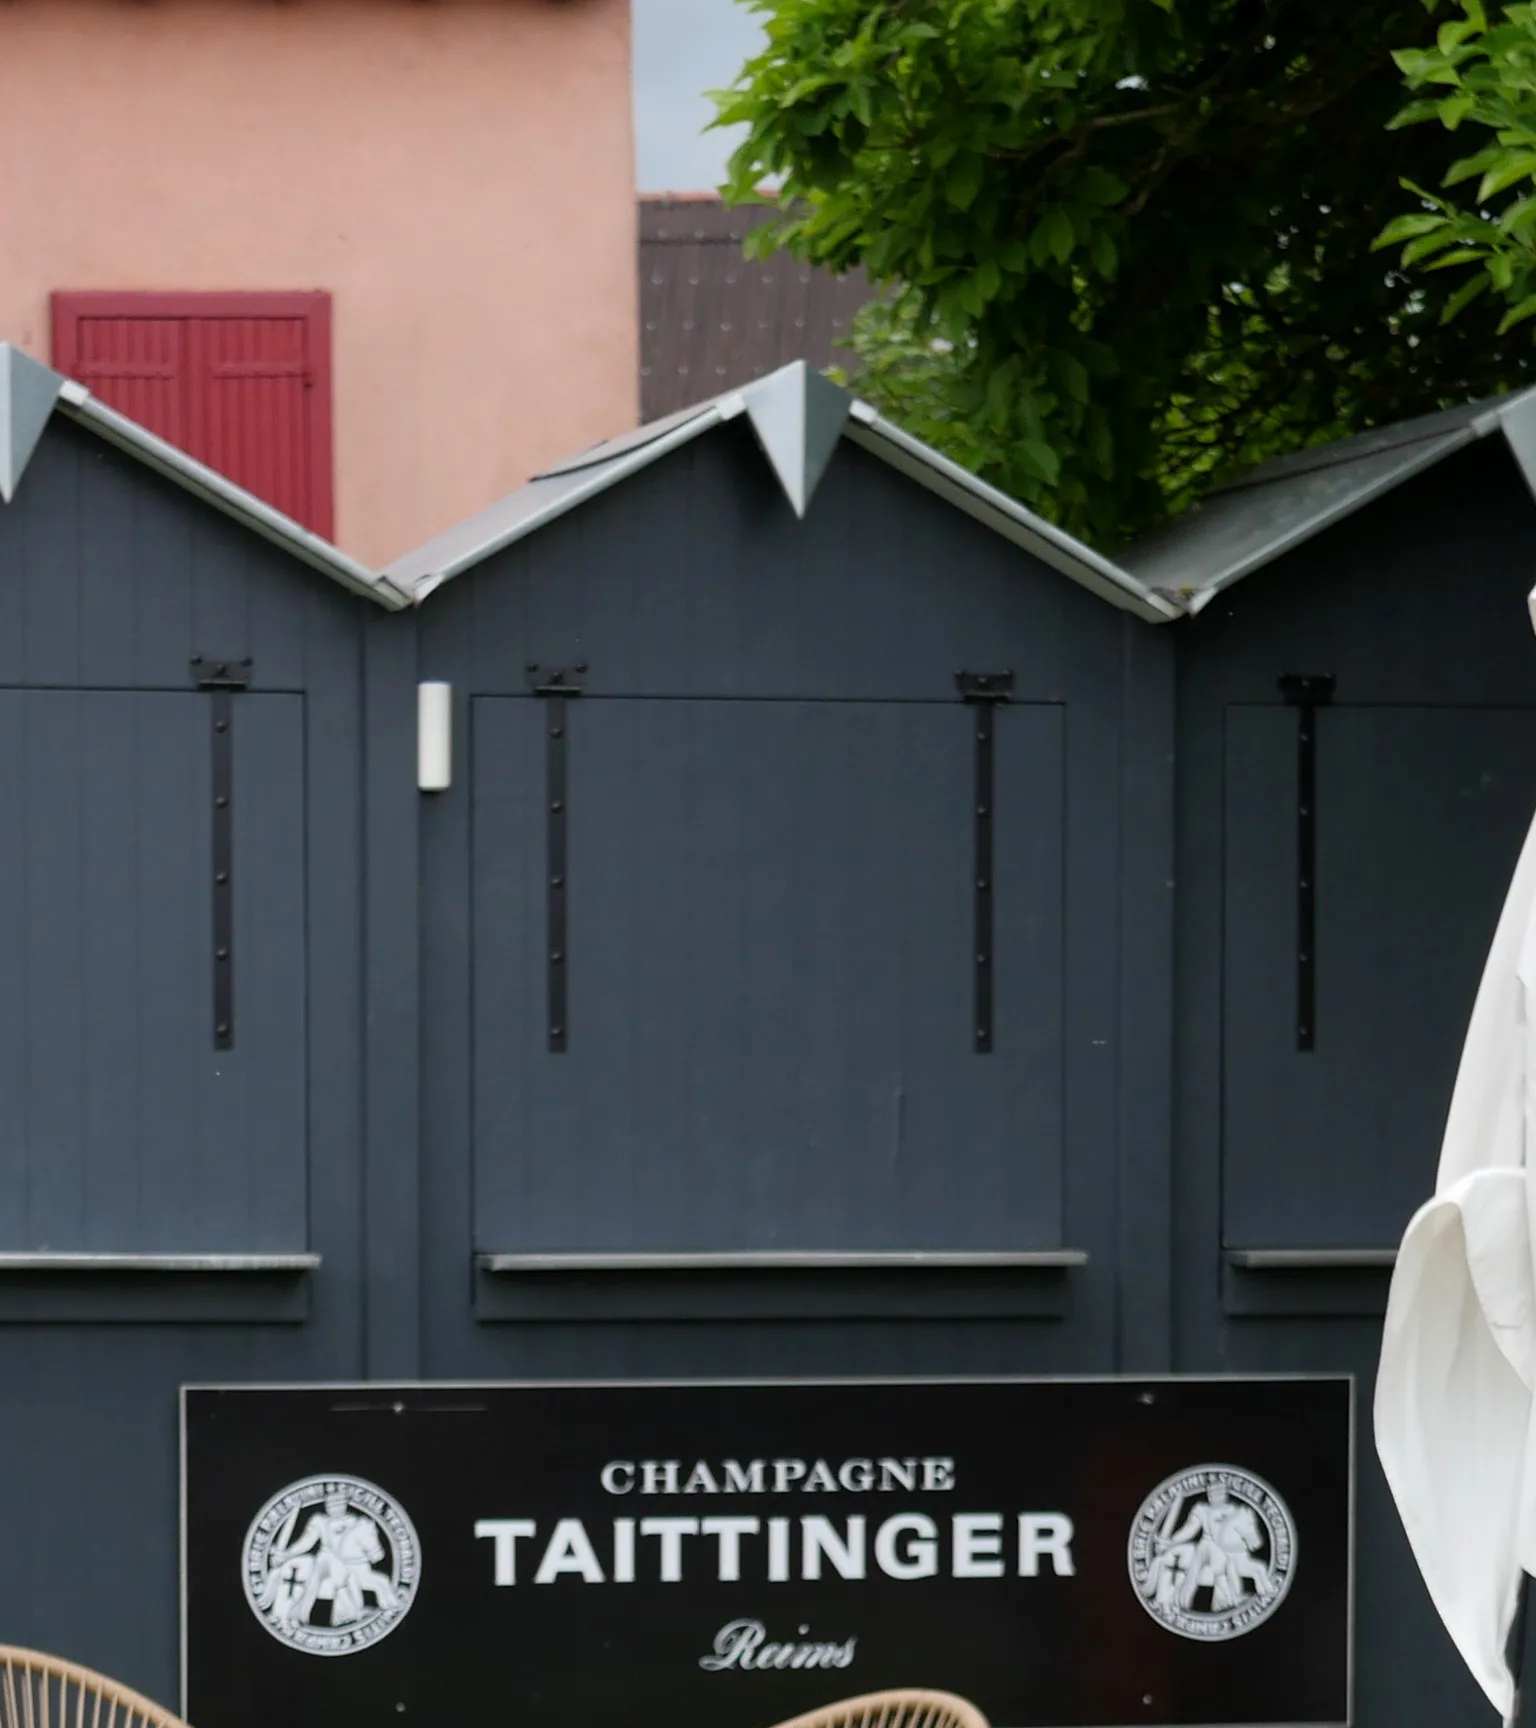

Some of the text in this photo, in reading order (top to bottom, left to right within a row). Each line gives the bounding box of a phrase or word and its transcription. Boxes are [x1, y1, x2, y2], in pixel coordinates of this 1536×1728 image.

[600, 1457, 956, 1495] CHAMPAGNE
[474, 1512, 1076, 1587] TAITTINGER
[698, 1617, 858, 1671] Reims
